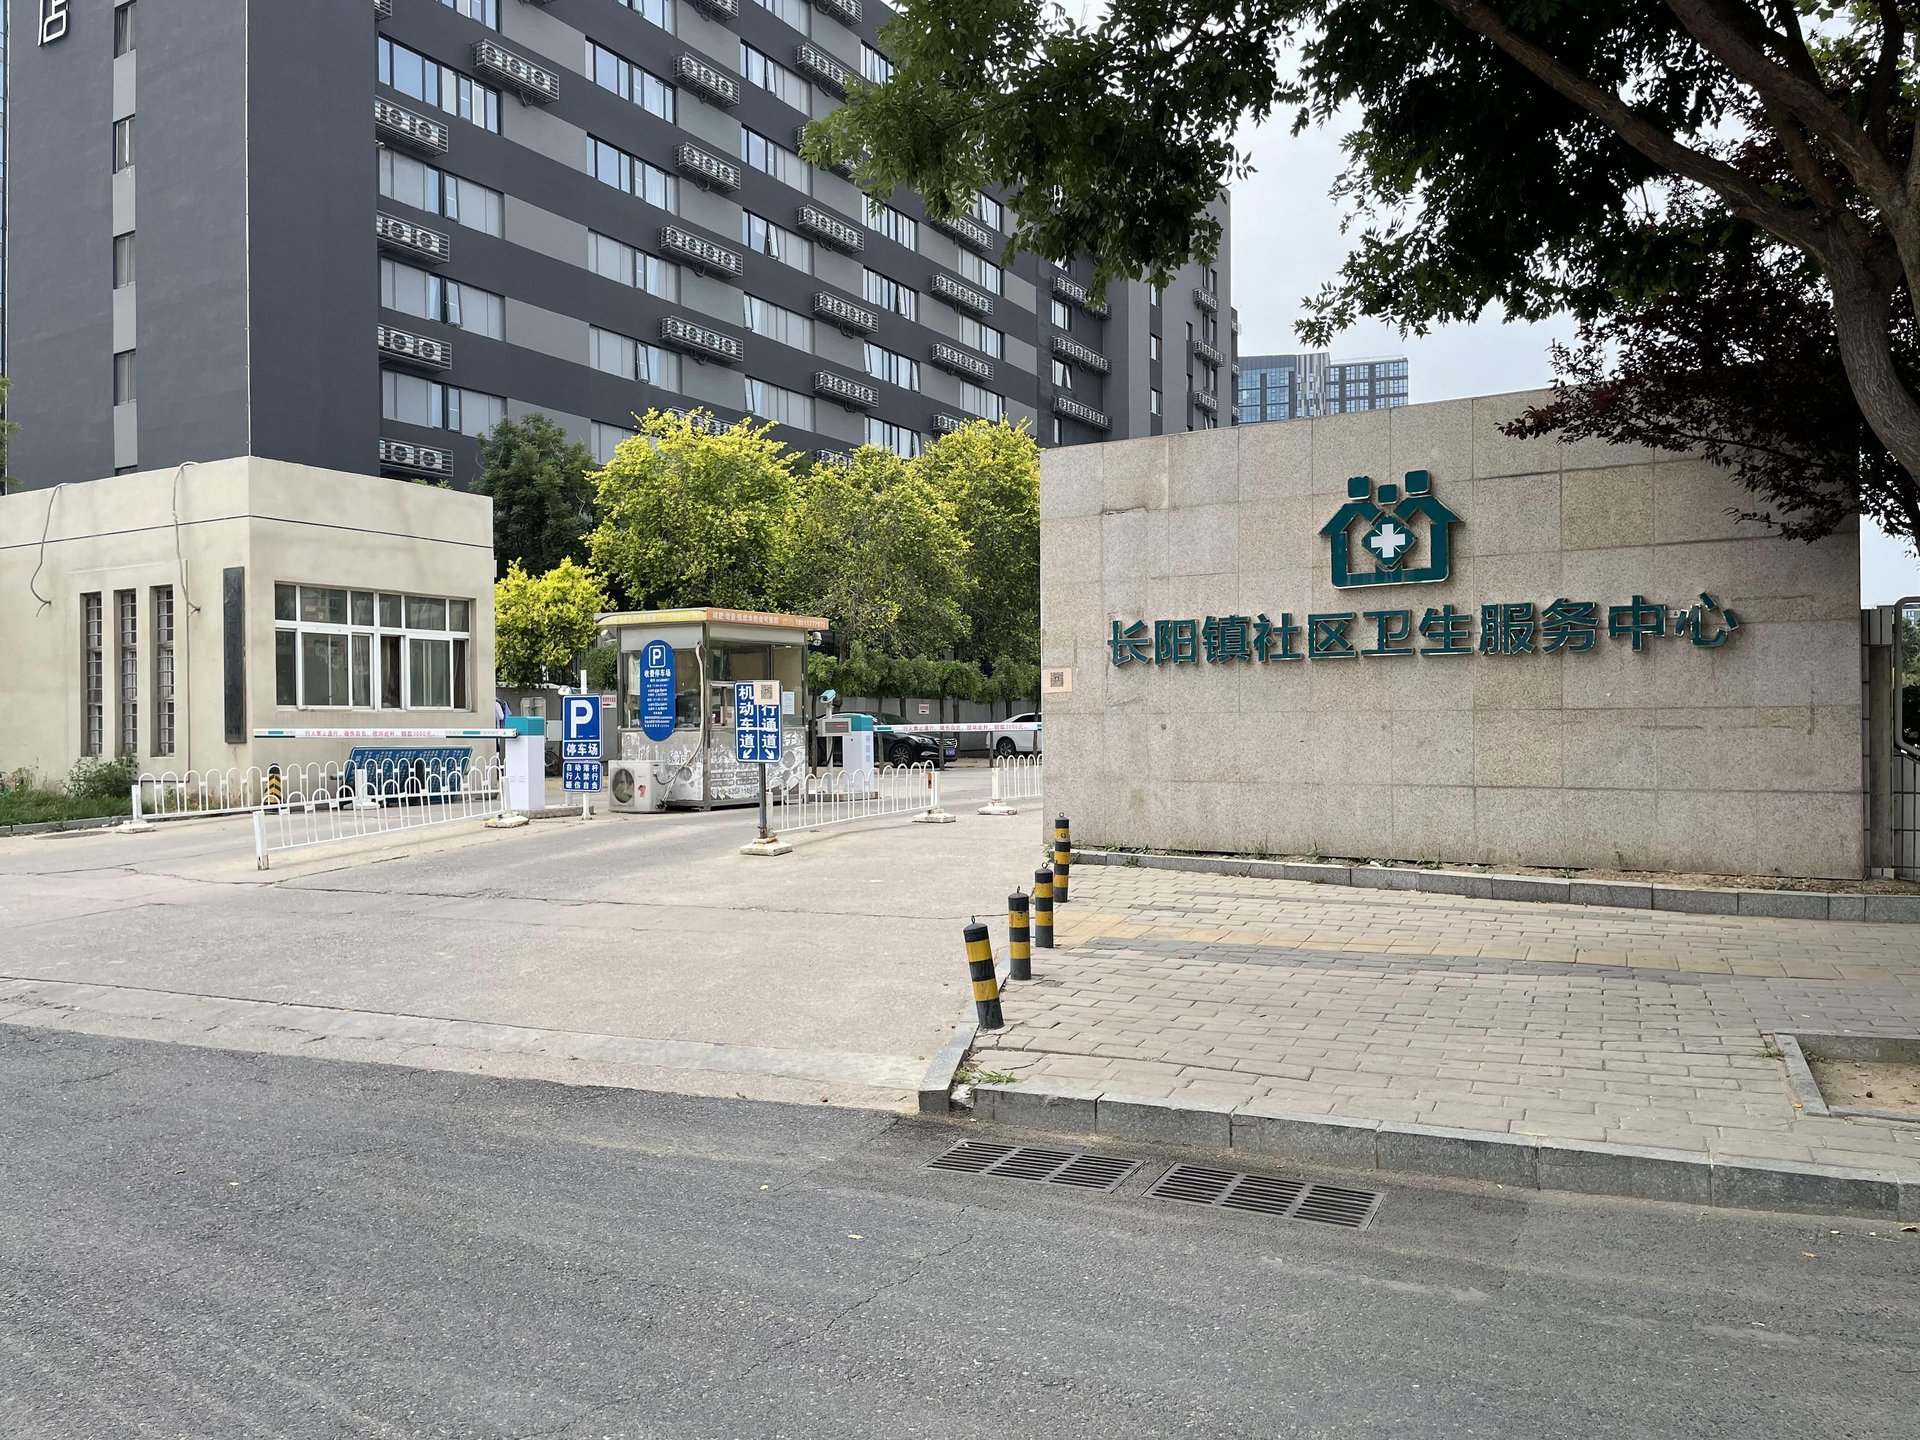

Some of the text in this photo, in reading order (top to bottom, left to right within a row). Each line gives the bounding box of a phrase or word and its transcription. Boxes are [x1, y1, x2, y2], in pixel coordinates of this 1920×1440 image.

[1106, 592, 1740, 668] 长阳镇社区卫生服务中心
[653, 649, 662, 665] P
[644, 669, 671, 678] 收费停车场
[570, 700, 594, 739] P
[739, 685, 755, 748] 机动车道
[761, 704, 779, 748] 行通道
[566, 743, 598, 756] 停车场
[566, 763, 599, 772] 自动落杆
[566, 772, 599, 781] 行人禁行
[566, 781, 599, 790] 砸伤自负
